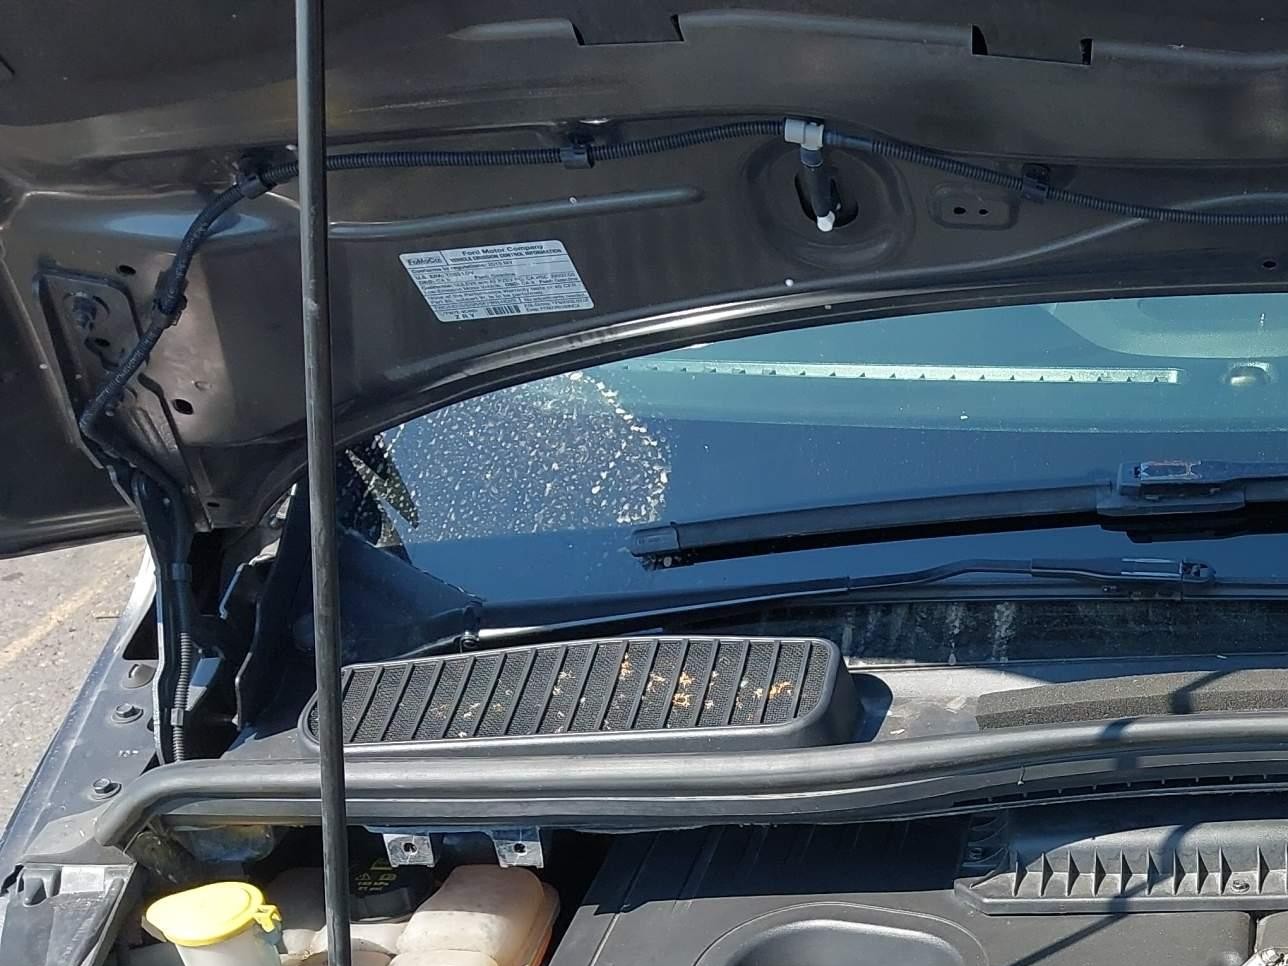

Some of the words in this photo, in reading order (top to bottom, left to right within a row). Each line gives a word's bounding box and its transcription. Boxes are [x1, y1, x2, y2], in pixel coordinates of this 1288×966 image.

[462, 249, 481, 257] Ford
[482, 247, 504, 255] Motor
[506, 244, 544, 253] Company
